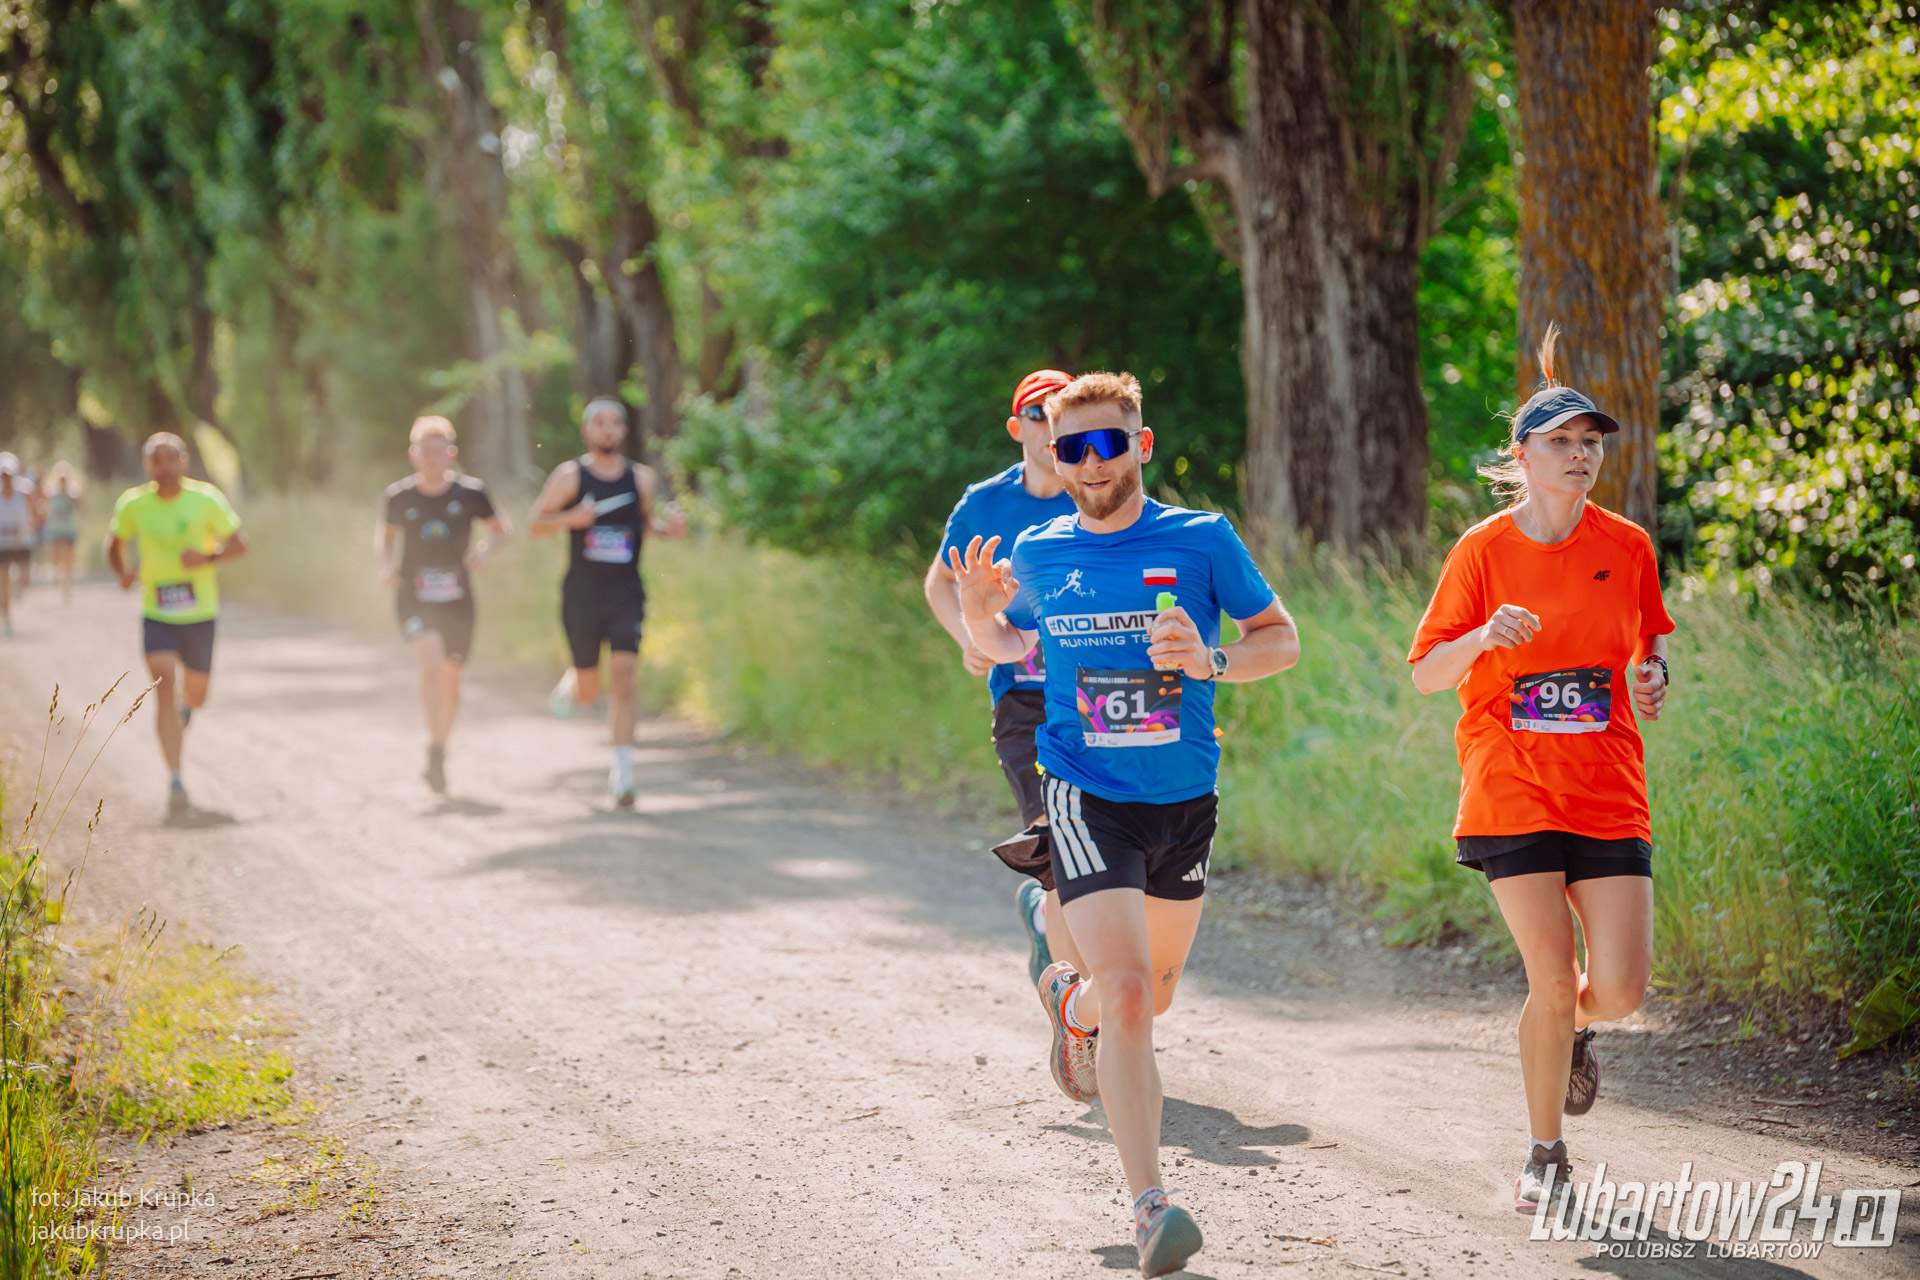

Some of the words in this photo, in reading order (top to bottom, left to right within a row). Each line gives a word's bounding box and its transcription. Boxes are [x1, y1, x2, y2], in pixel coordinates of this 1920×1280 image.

[1593, 569, 1611, 581] 4F
[1059, 635, 1126, 648] RUNNING
[1131, 633, 1151, 644] TE
[1105, 690, 1151, 720] 61
[1540, 681, 1582, 709] 96
